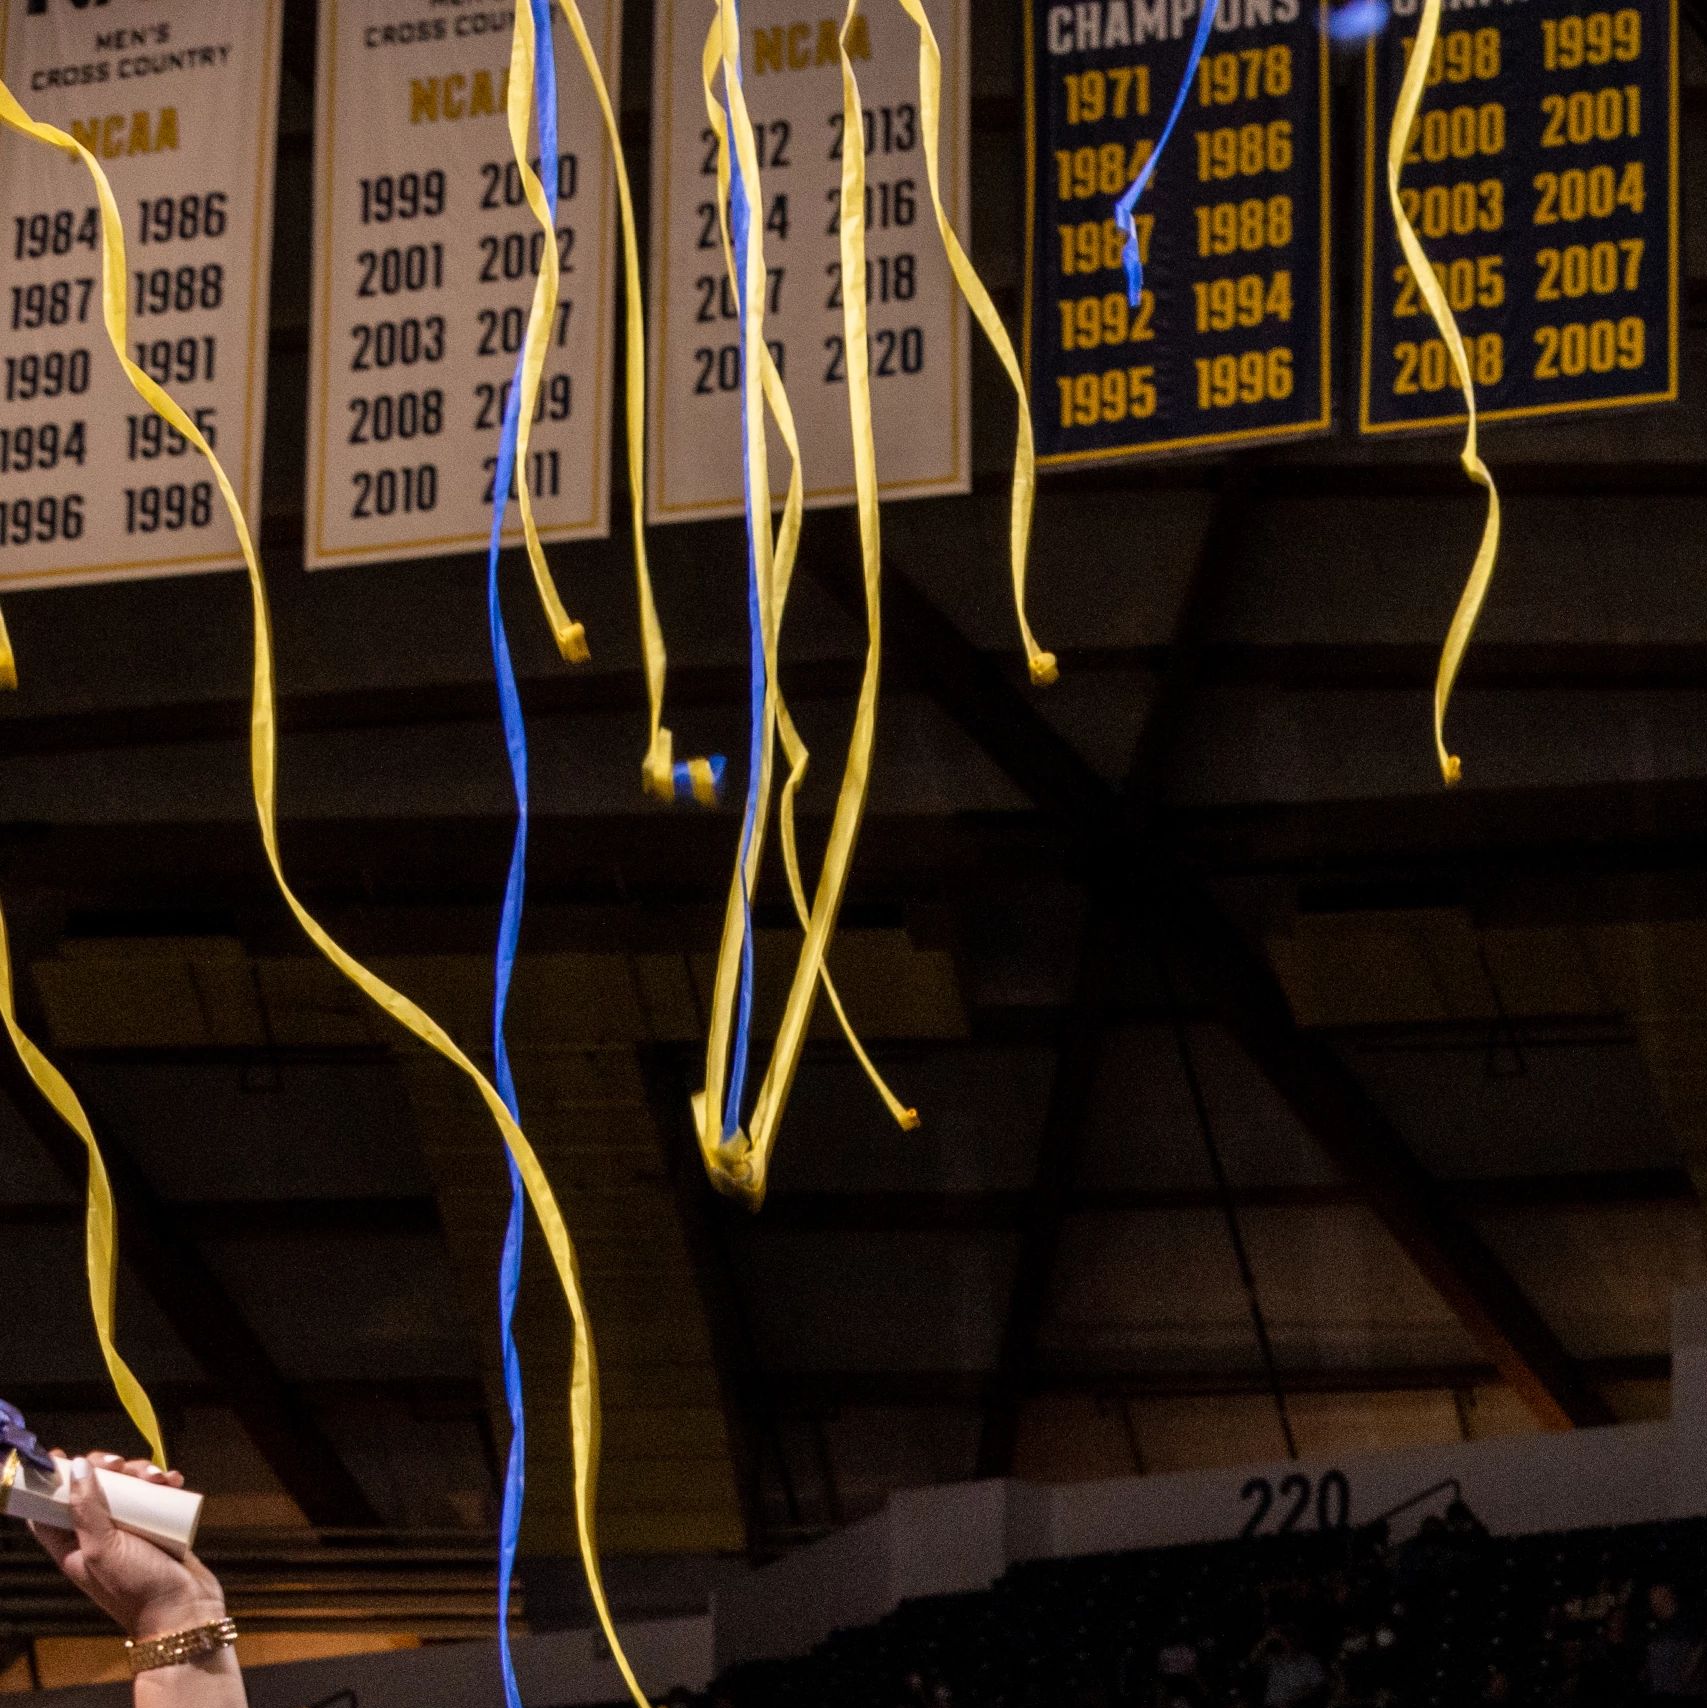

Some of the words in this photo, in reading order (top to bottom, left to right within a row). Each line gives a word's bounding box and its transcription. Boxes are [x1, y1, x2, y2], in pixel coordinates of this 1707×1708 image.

[364, 18, 448, 48] CROSS
[1540, 7, 1643, 72] 1999
[31, 61, 110, 91] CROSS
[117, 43, 230, 79] COUNTRY
[1063, 63, 1150, 127] 1971
[1197, 42, 1294, 107] 1978
[70, 106, 179, 163] NCAA
[700, 119, 792, 176] 212
[1540, 83, 1642, 149] 2001
[1194, 118, 1294, 183] 1986
[358, 167, 447, 224] 1999
[480, 153, 578, 210] 200
[697, 192, 789, 250] 24
[1397, 177, 1505, 240] 2003
[1532, 161, 1646, 227] 2004
[14, 206, 99, 261] 1984
[139, 190, 228, 246] 1986
[1193, 194, 1294, 258] 1988
[11, 277, 95, 331] 1987
[134, 262, 224, 317] 1988
[356, 243, 445, 299] 2001
[1534, 237, 1646, 302] 2007
[349, 316, 446, 373] 2003
[477, 301, 573, 357] 207
[1058, 287, 1156, 351] 1992
[1192, 268, 1294, 334] 1994
[5, 348, 91, 401] 1990
[135, 335, 216, 386] 1991
[823, 325, 925, 384] 220
[1532, 315, 1646, 381] 2009
[348, 388, 444, 445] 2008
[1056, 364, 1157, 430] 1995
[1194, 345, 1294, 411] 1996
[0, 420, 87, 475] 1994
[124, 479, 214, 536] 1998
[350, 463, 438, 519] 2010
[481, 449, 560, 505] 211
[1239, 1468, 1352, 1538] 220
